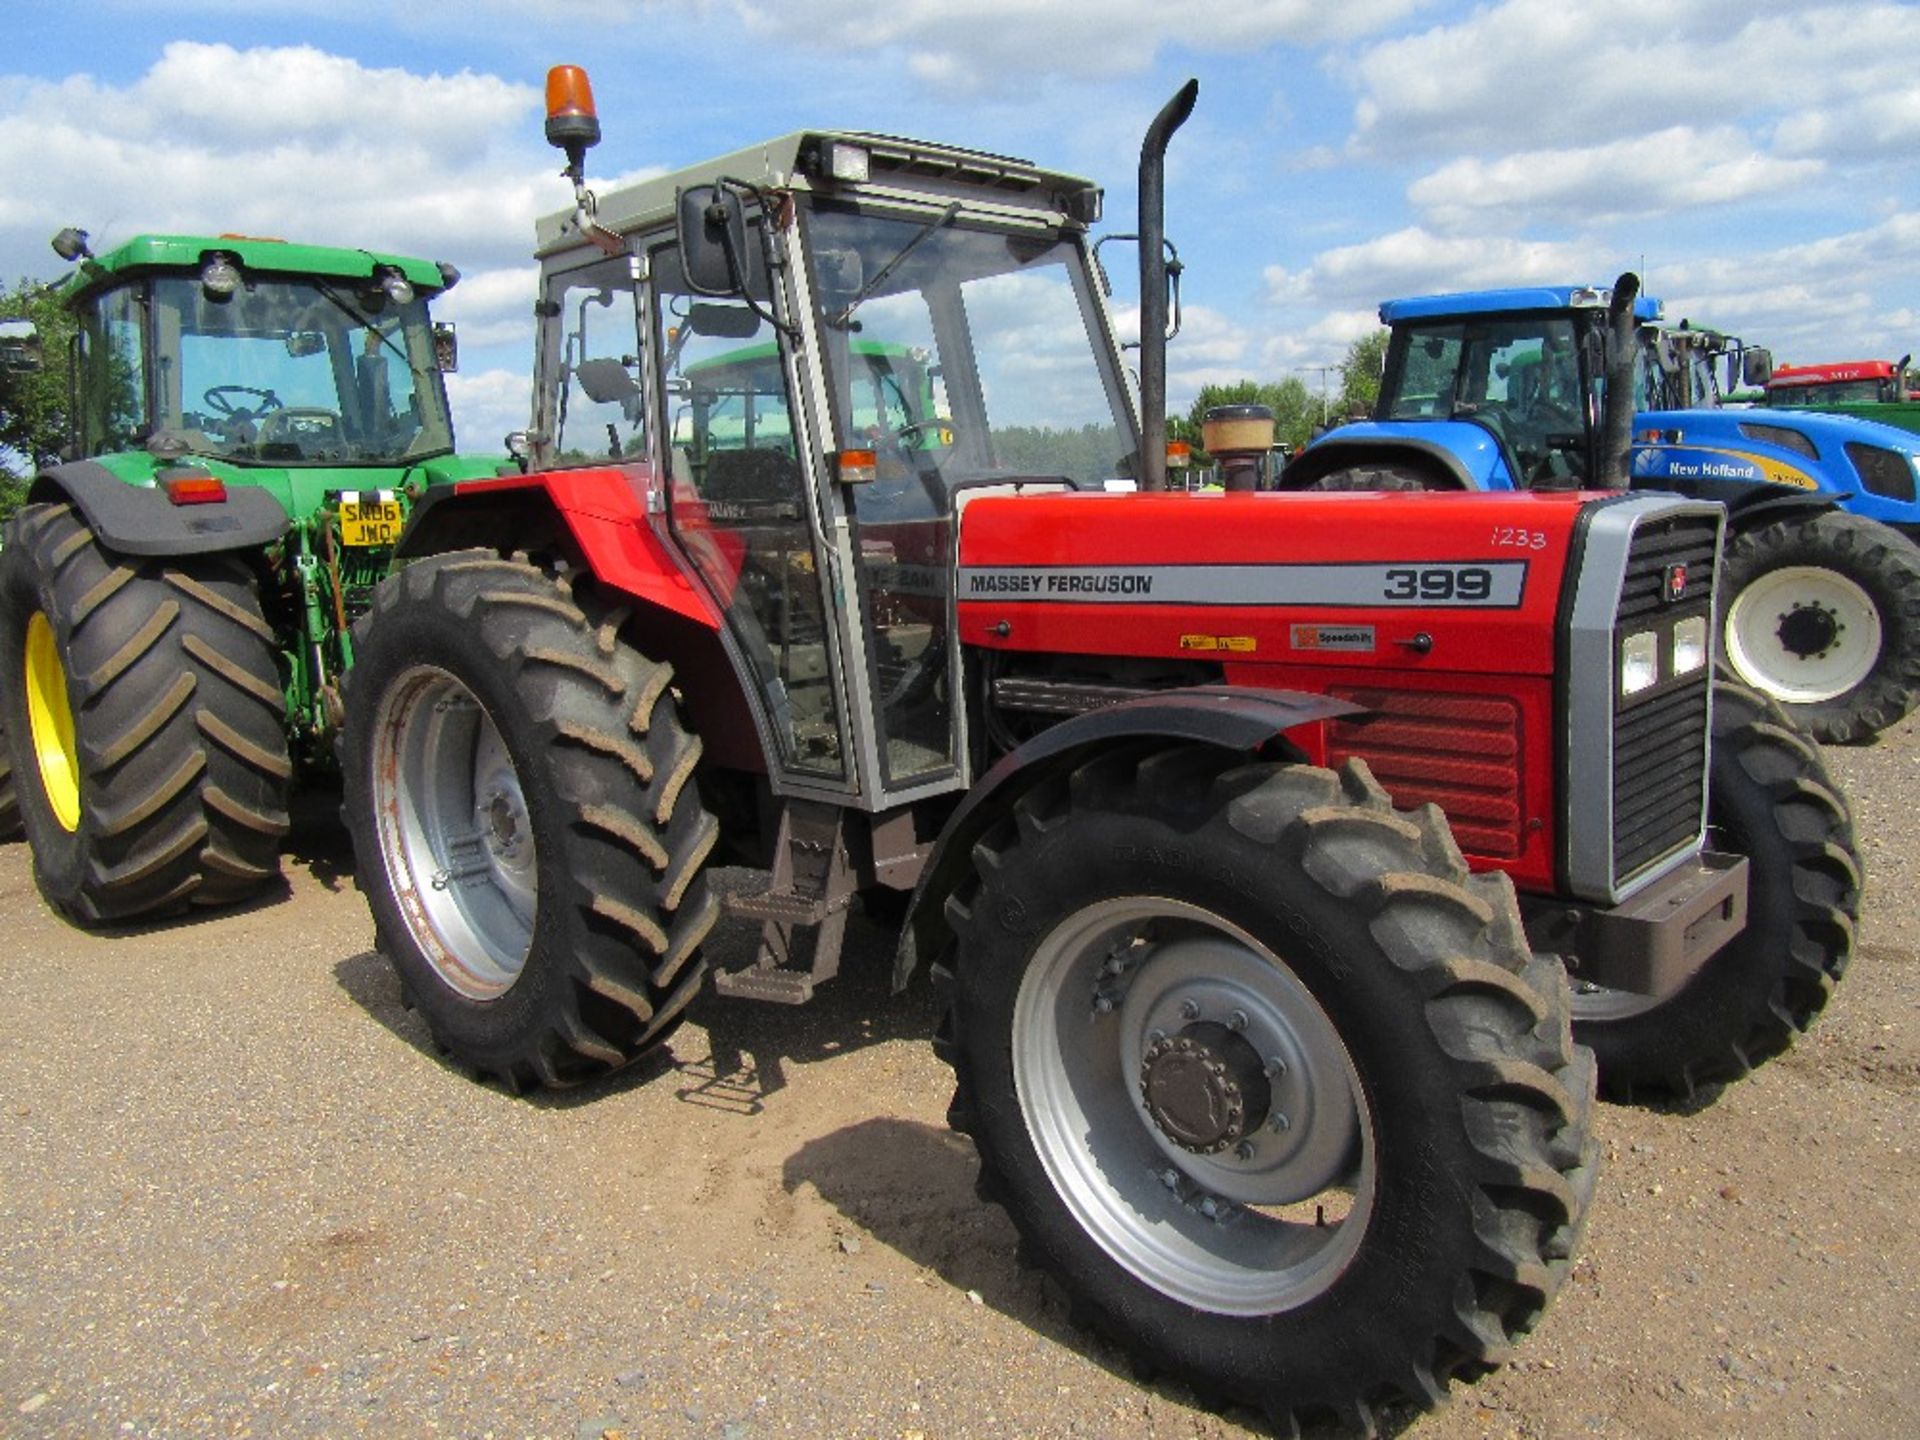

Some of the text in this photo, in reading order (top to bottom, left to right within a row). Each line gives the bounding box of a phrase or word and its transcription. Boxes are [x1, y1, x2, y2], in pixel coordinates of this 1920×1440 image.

[1669, 462, 1754, 478] New Holland
[345, 504, 397, 521] SN06
[1491, 526, 1547, 550] 1233
[970, 575, 1153, 594] MASSEY FERGUSON
[1384, 568, 1492, 600] 399
